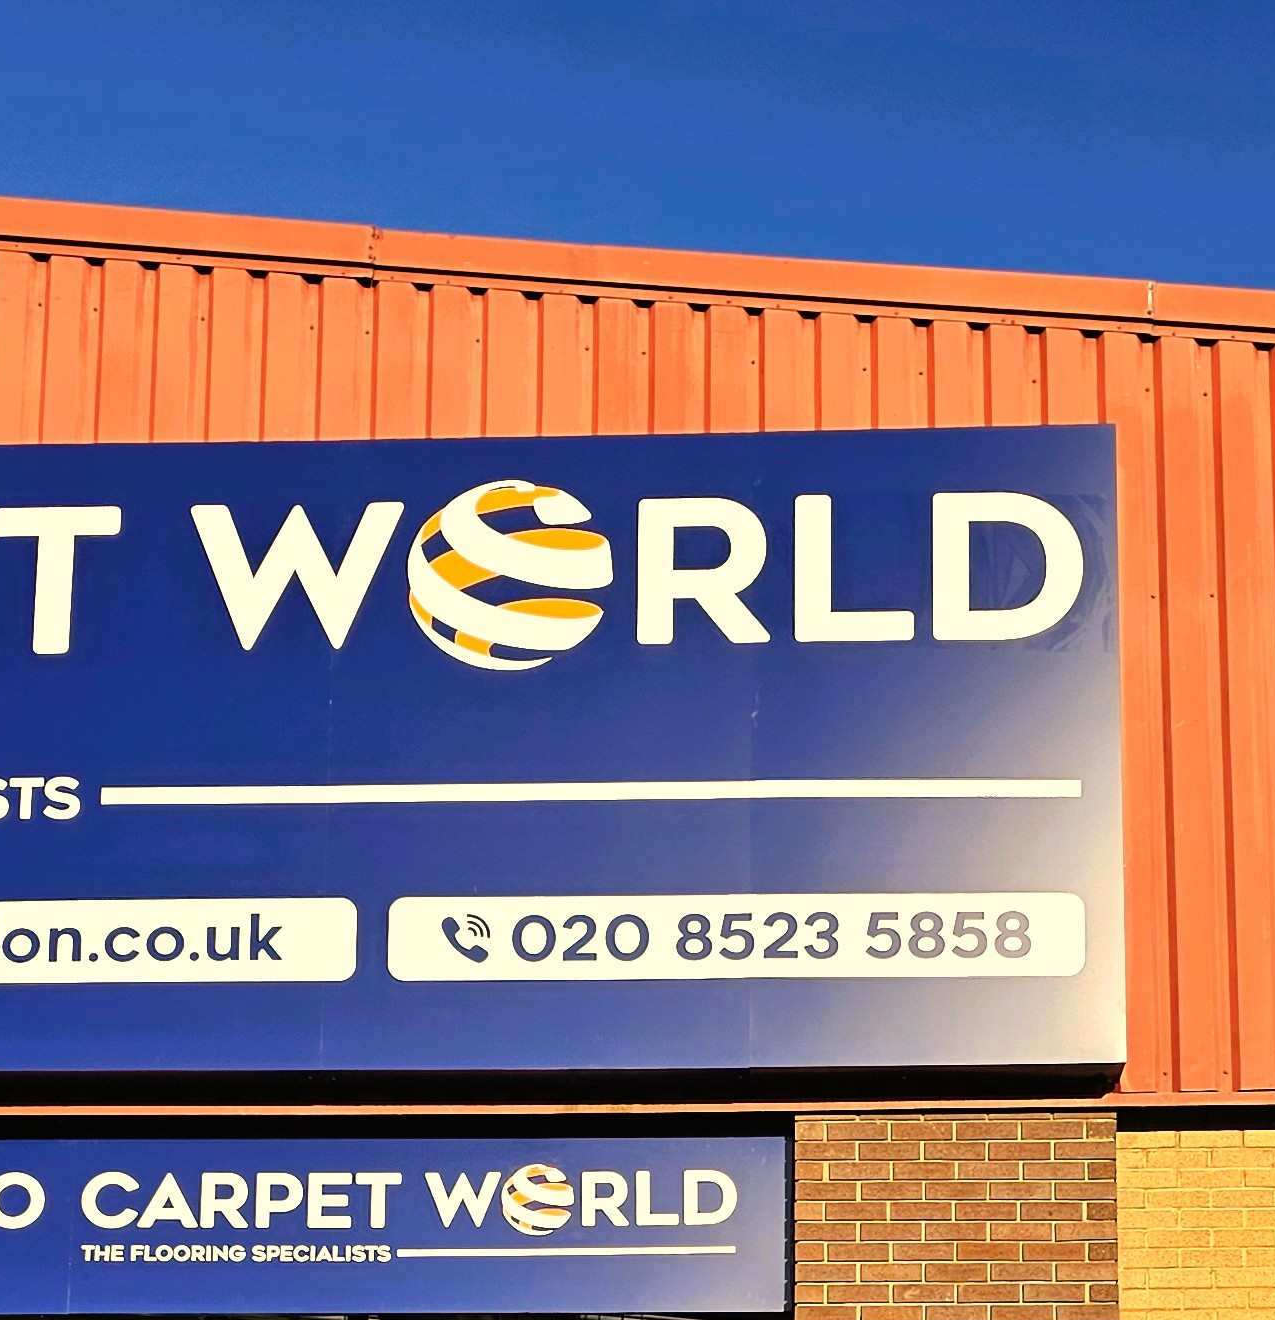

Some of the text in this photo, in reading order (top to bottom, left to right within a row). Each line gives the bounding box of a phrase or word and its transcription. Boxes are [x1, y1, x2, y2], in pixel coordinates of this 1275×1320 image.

[190, 478, 1085, 672] WORLD
[511, 910, 1033, 963] 020 8523 5858
[81, 1171, 403, 1229] CARPET
[424, 1163, 738, 1236] WORLD
[80, 1244, 392, 1263] THE FLOORING SPECIALISTS
